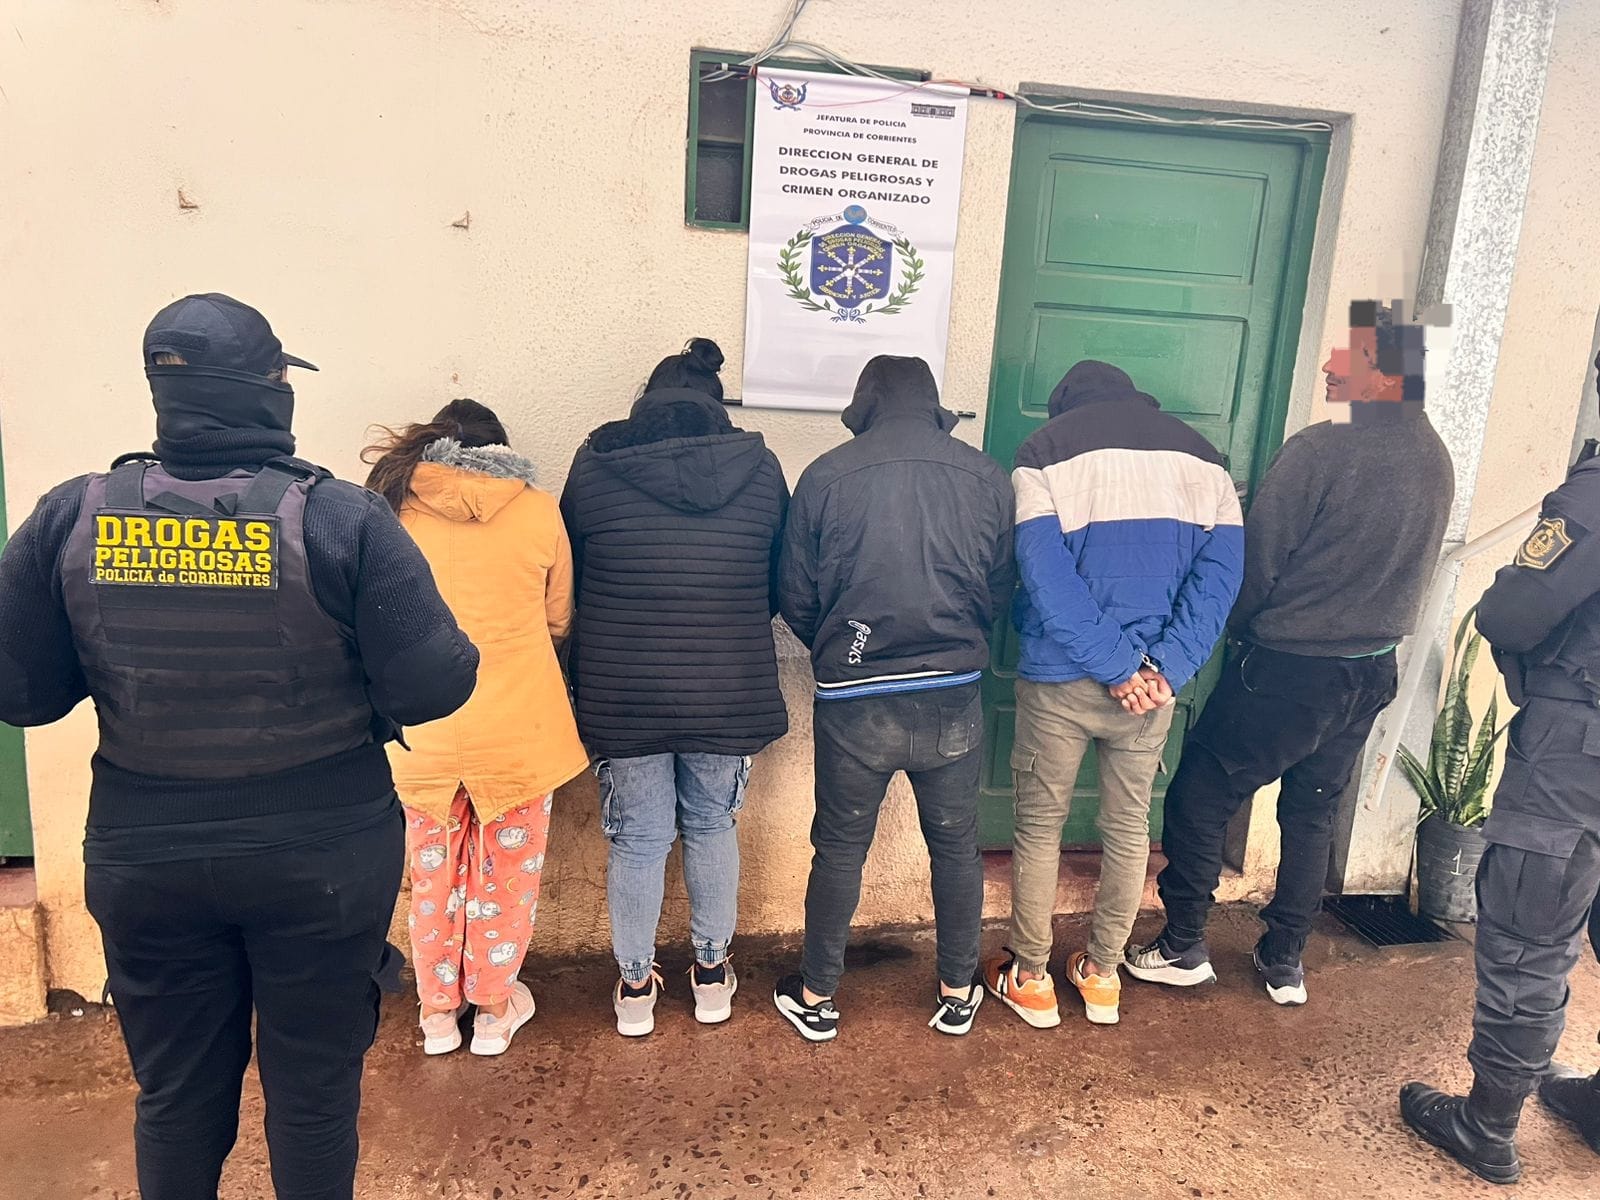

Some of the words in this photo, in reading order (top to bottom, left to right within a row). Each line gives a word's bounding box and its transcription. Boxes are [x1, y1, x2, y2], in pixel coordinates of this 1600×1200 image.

[816, 114, 858, 124] JEFATURA
[873, 119, 907, 128] POLICIA
[803, 128, 850, 138] PROVINCIA
[866, 133, 917, 143] CORRIENTES
[778, 146, 852, 161] DIRECCION
[857, 153, 918, 167] GENERAL
[922, 159, 938, 169] DE
[779, 165, 837, 179] DROGAS
[841, 171, 922, 186] PELIGROSAS
[926, 178, 934, 187] Y
[782, 184, 833, 197] CRIMEN
[838, 189, 931, 204] ORGANIZADO
[95, 515, 272, 551] DROGAS
[95, 547, 272, 573] PELIGROSAS
[95, 569, 154, 583] POLICIA
[158, 570, 175, 583] de
[179, 571, 271, 587] CORRIENTES
[1450, 847, 1463, 876] 1
